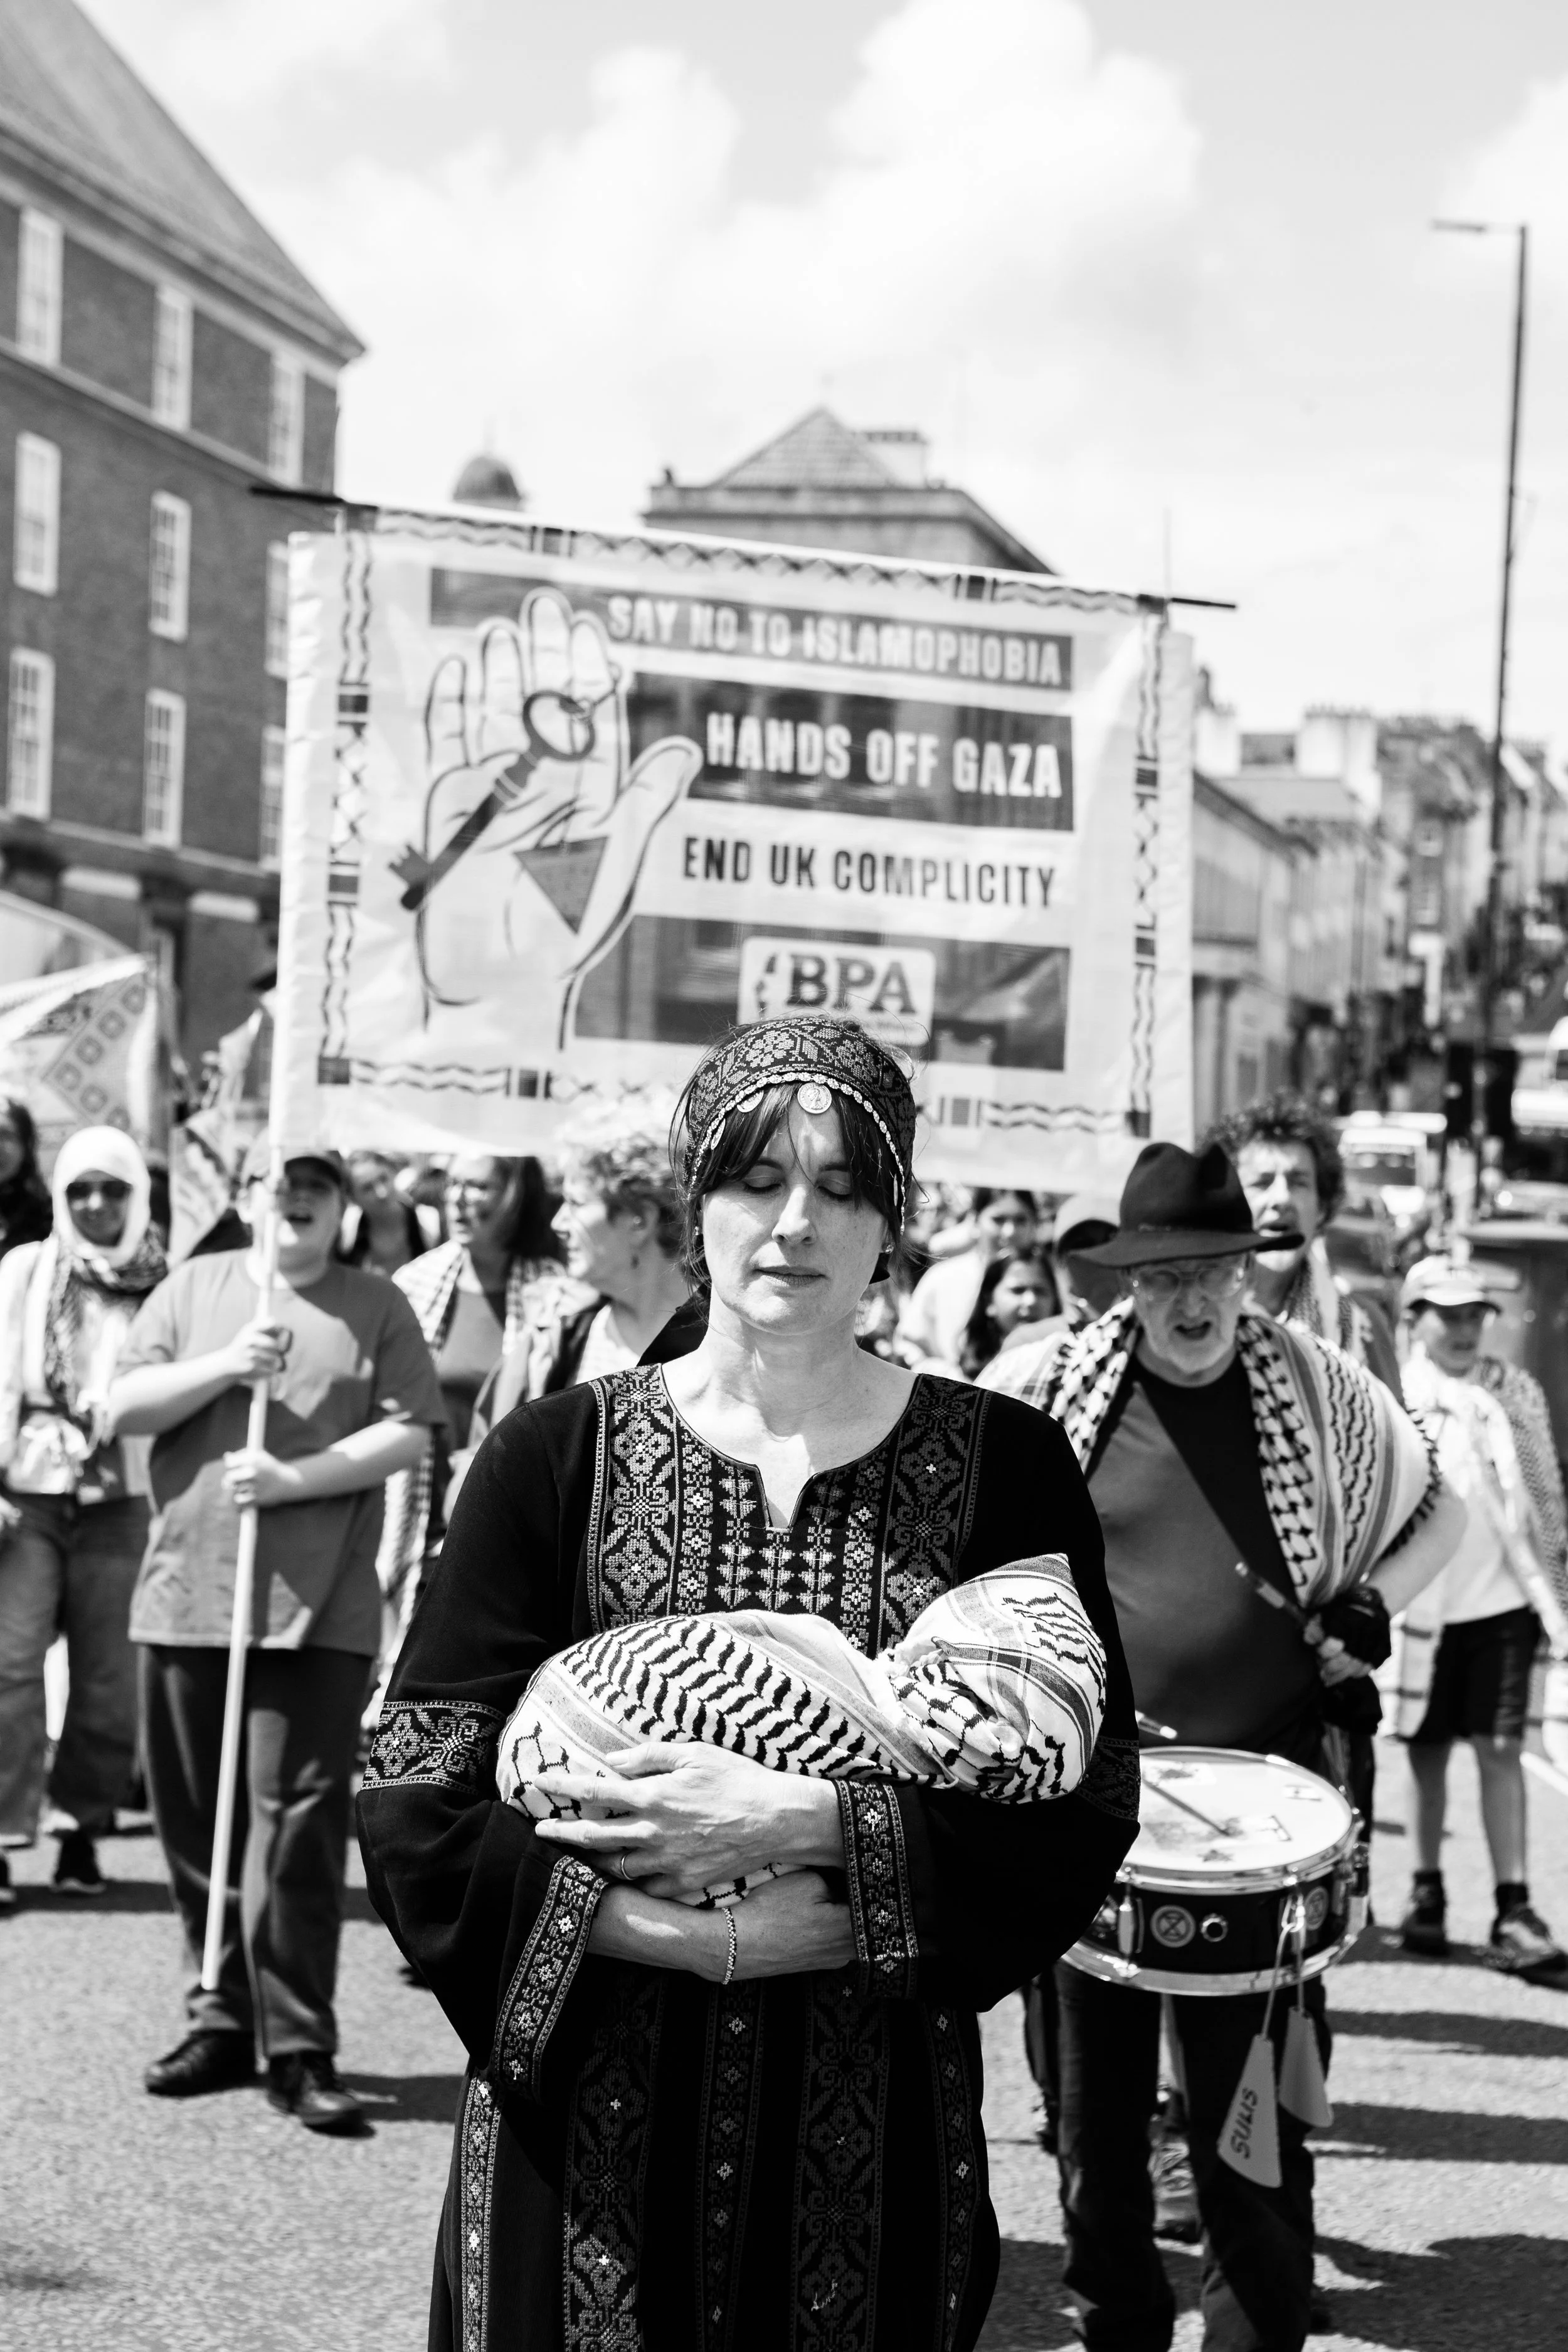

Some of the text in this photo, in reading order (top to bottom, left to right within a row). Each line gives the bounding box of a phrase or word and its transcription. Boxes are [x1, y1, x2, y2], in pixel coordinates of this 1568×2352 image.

[608, 596, 1062, 686] SAY NO TO ISLAMOPHOBIA
[707, 712, 1062, 798] HANDS OFF GAZA
[684, 836, 1055, 908] END UK COMPLICITY
[786, 953, 917, 1014] BPA
